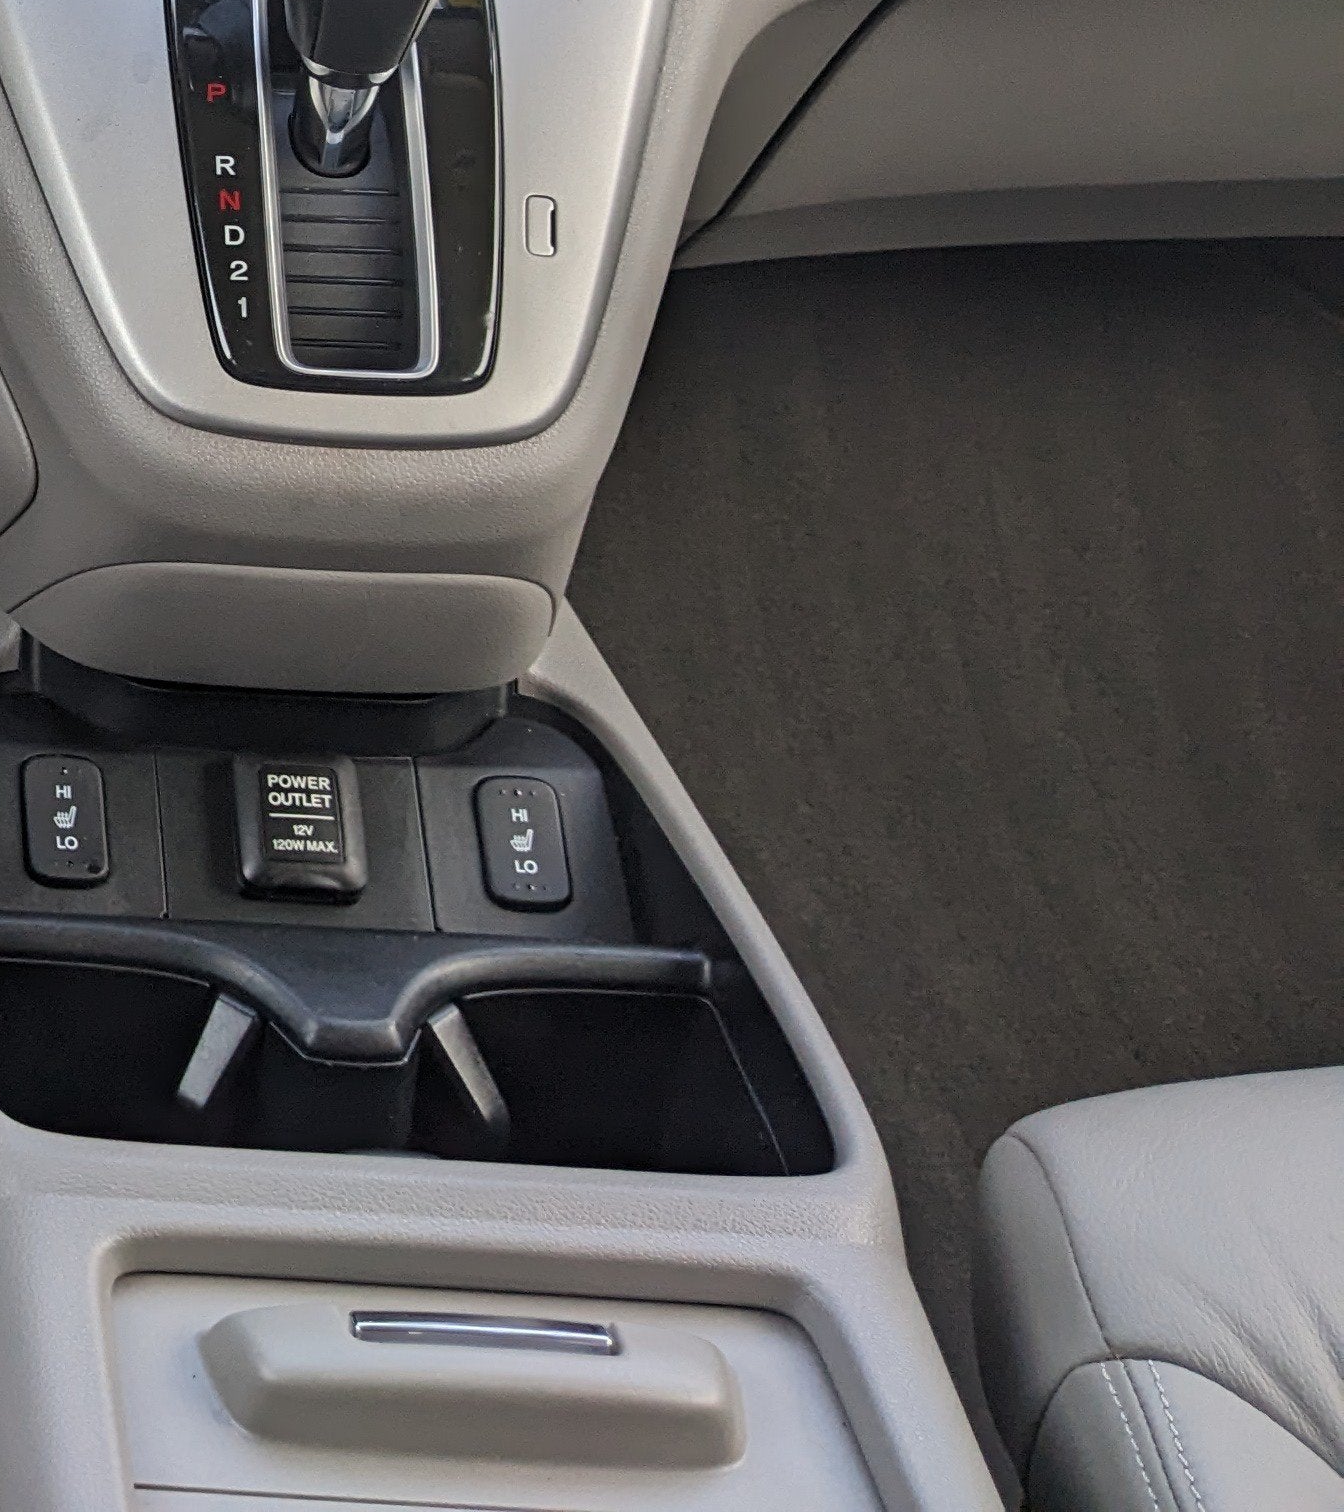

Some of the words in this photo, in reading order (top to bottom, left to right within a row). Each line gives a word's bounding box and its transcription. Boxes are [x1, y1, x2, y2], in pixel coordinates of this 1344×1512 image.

[206, 82, 227, 103] P
[215, 155, 236, 176] R
[218, 189, 241, 211] N
[224, 225, 245, 246] D
[229, 260, 249, 281] 2
[237, 296, 248, 318] 1
[266, 774, 331, 790] POWER
[55, 784, 72, 799] HI
[268, 791, 332, 808] OUTLET
[510, 808, 528, 822] HI
[292, 824, 314, 836] 12V
[56, 835, 78, 850] LO
[272, 838, 305, 851] 120W
[306, 840, 339, 853] MAX.
[514, 859, 538, 874] LO
